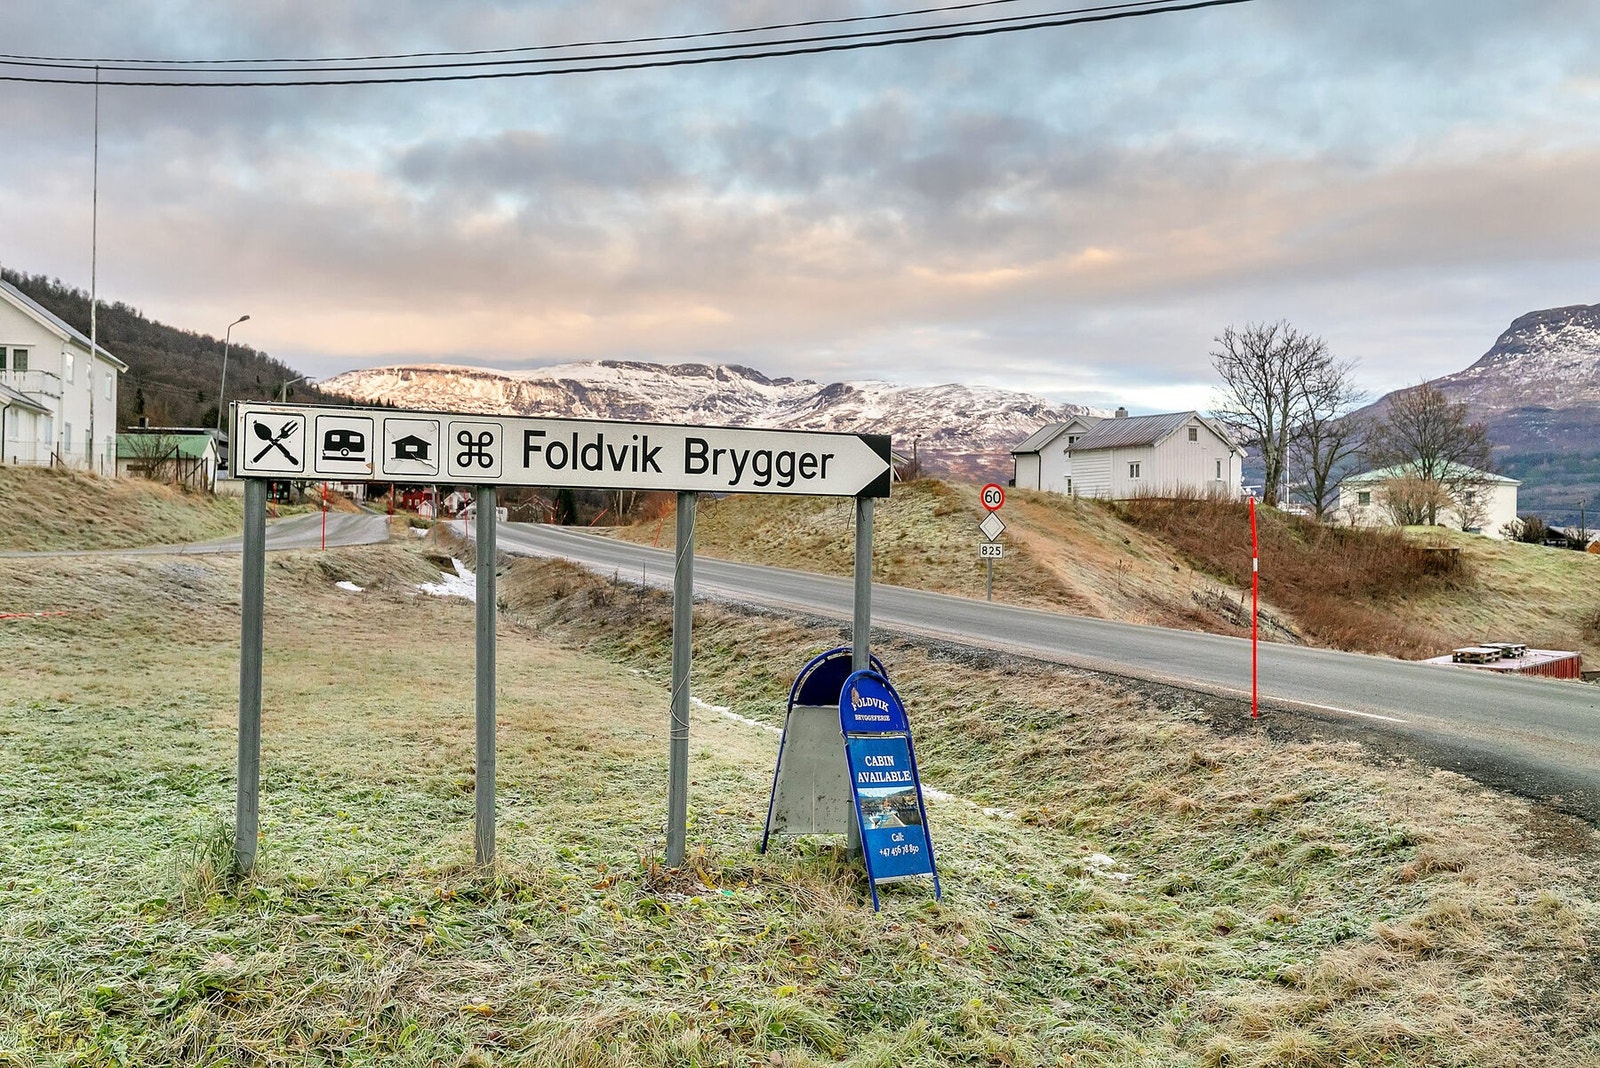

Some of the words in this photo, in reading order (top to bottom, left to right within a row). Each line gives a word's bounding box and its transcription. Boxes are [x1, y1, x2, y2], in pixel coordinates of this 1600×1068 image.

[523, 429, 663, 474] Foldvik
[684, 437, 835, 487] Brygger
[984, 490, 1002, 504] 60
[981, 546, 1001, 556] 825
[865, 755, 895, 767] CABIN
[858, 770, 912, 783] AVAILABLE
[891, 832, 905, 842] Call:
[879, 847, 890, 857] +47
[891, 845, 902, 857] 456
[902, 844, 909, 856] 78
